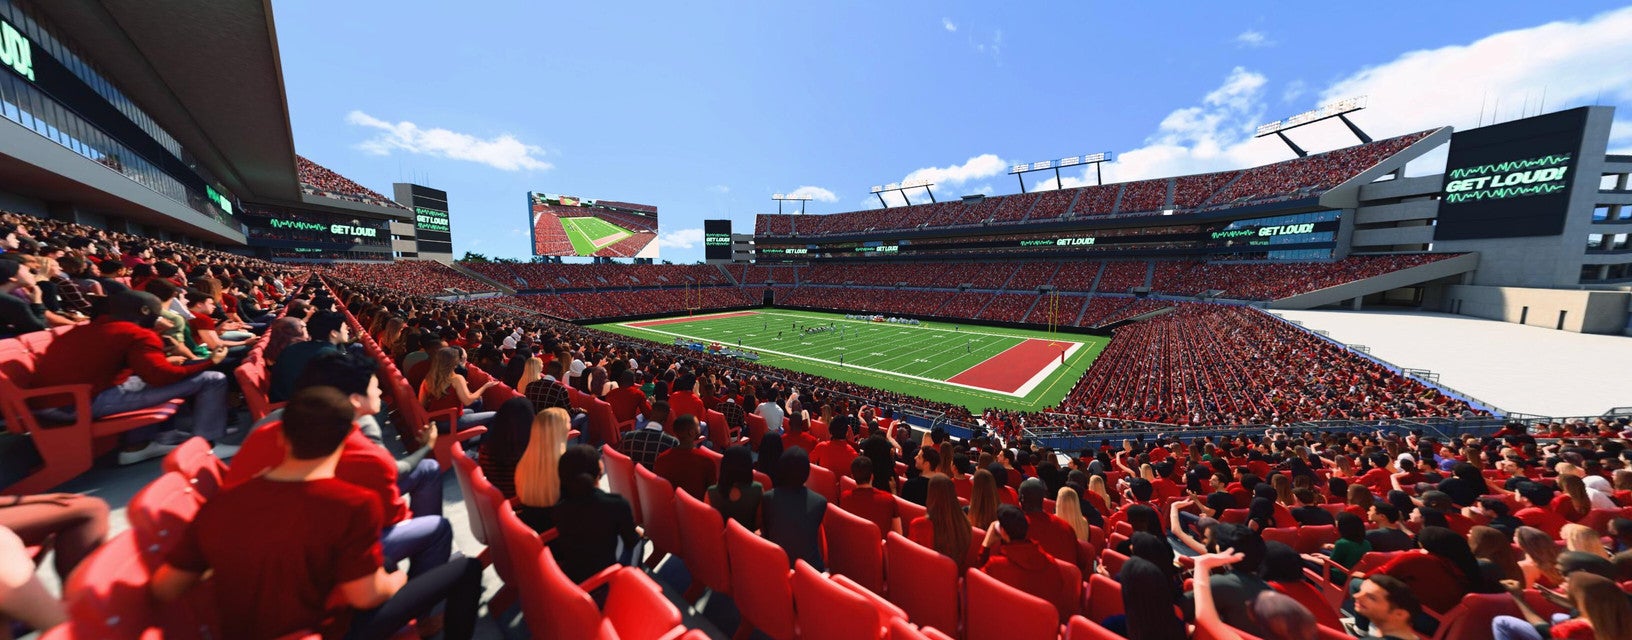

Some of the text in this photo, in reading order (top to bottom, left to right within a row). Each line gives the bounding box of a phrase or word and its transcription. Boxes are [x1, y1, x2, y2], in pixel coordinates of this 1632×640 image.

[1446, 166, 1568, 192] GET LOUD!
[416, 215, 430, 223] GET
[330, 224, 376, 237] GET LOUD!
[1258, 223, 1315, 237] GET LOUD!
[1056, 237, 1095, 246] GET LOUD!
